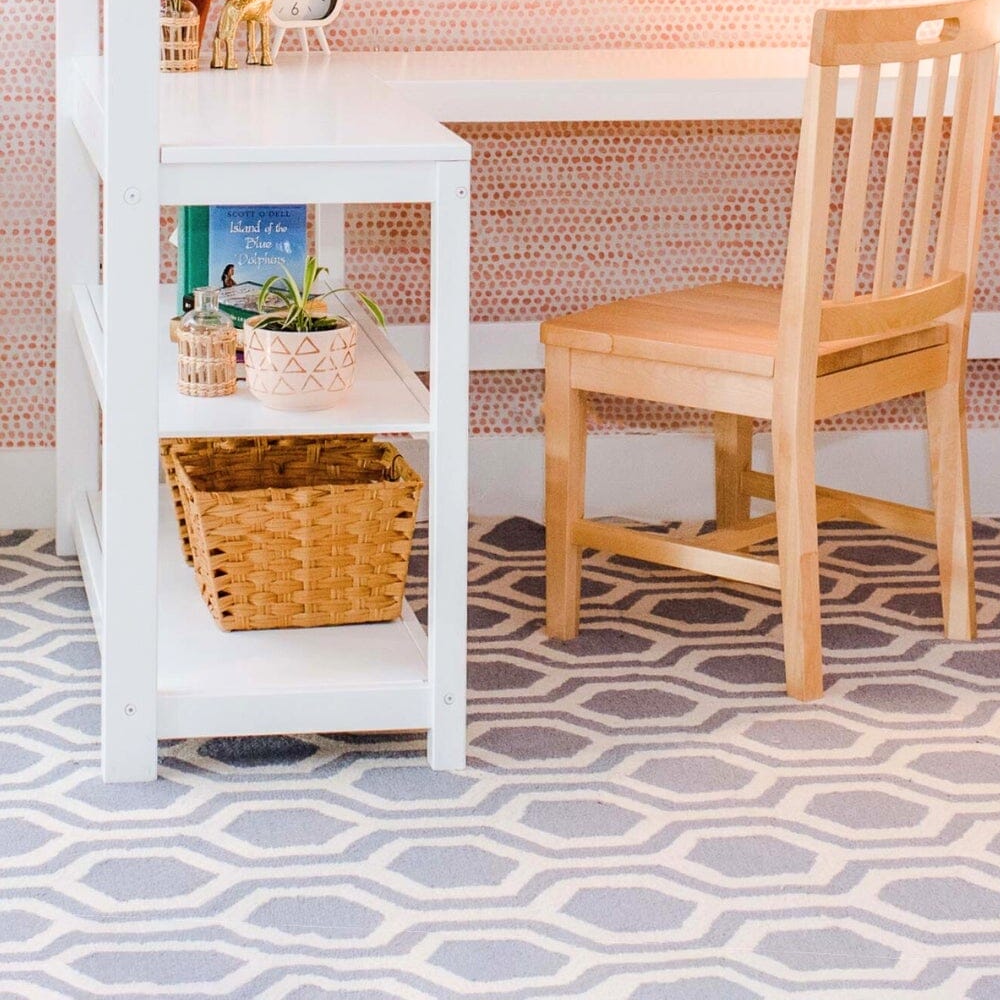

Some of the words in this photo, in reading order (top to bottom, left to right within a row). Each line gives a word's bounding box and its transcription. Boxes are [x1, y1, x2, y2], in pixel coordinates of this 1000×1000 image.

[291, 2, 299, 15] 6
[227, 210, 254, 218] SCOTT
[258, 210, 291, 218] O'DELL
[229, 220, 261, 233] Island
[264, 222, 273, 235] of
[275, 222, 288, 233] the
[244, 235, 273, 249] Blue
[236, 252, 286, 269] Dolphins
